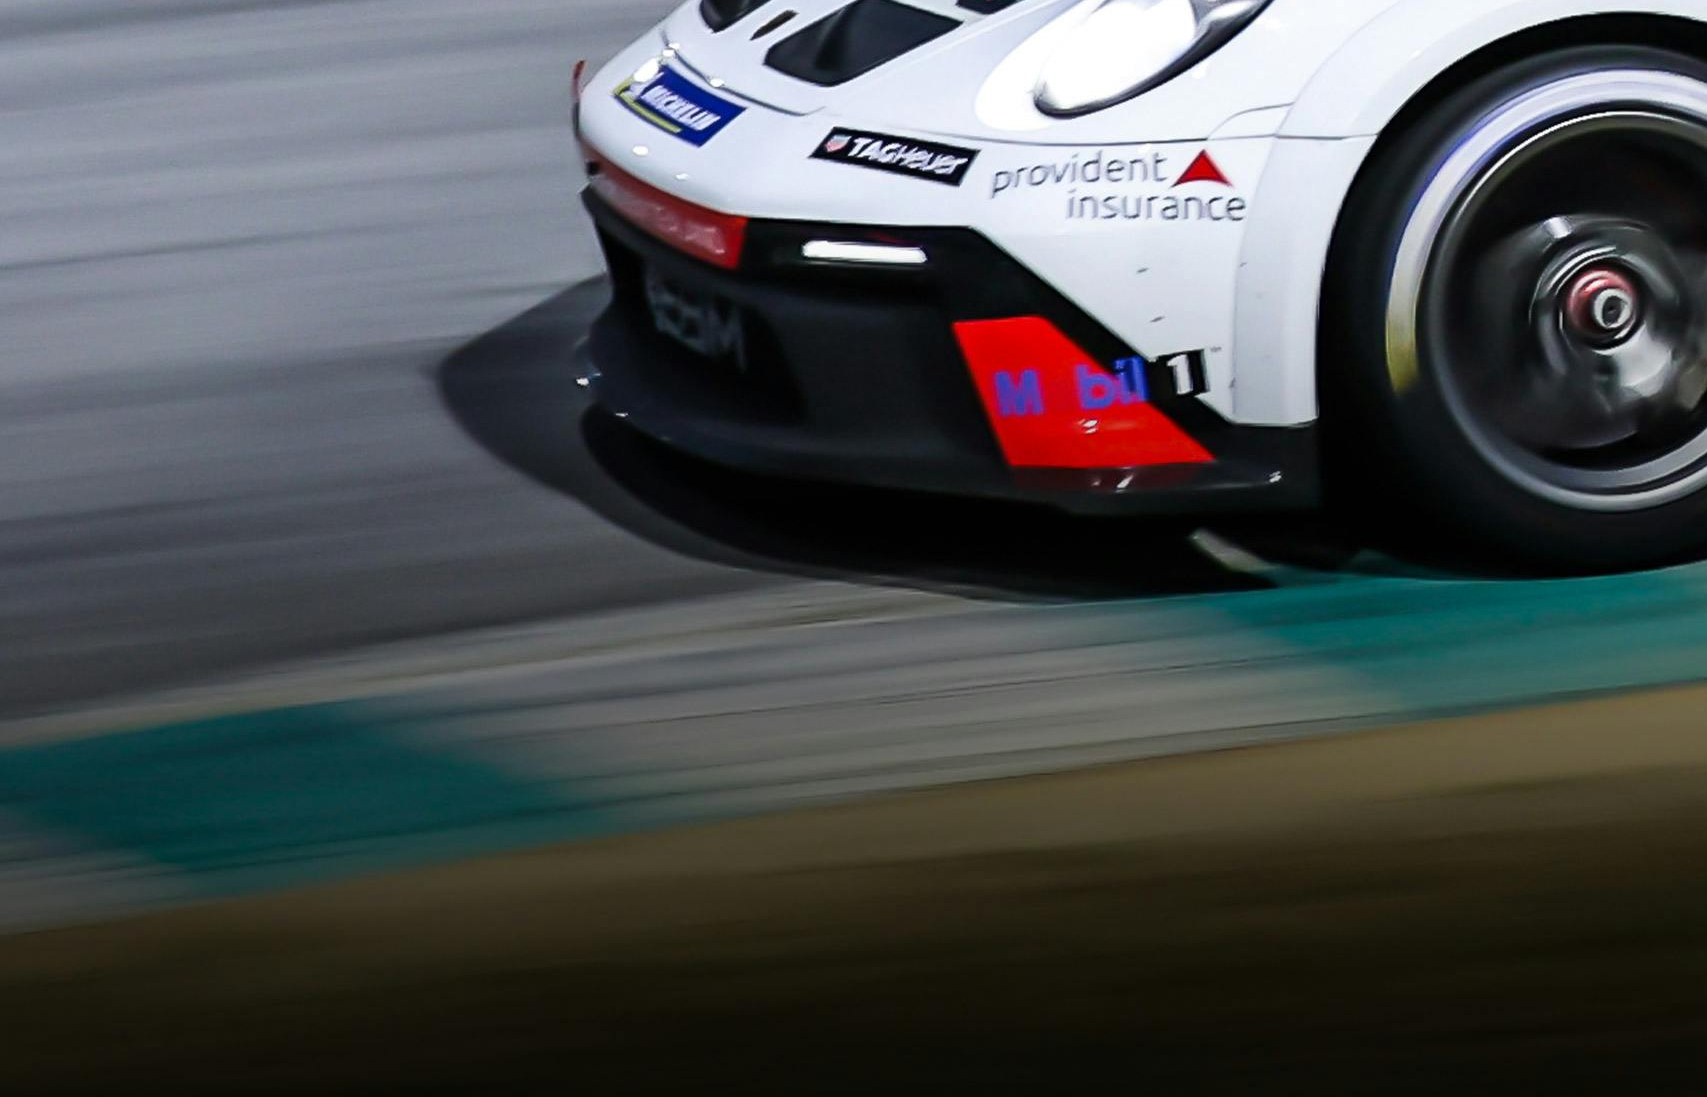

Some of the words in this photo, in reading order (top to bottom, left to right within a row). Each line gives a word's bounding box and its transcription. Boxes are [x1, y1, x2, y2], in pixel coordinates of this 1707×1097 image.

[991, 150, 1168, 199] provident
[1066, 188, 1246, 221] insurance
[1166, 353, 1194, 395] 1
